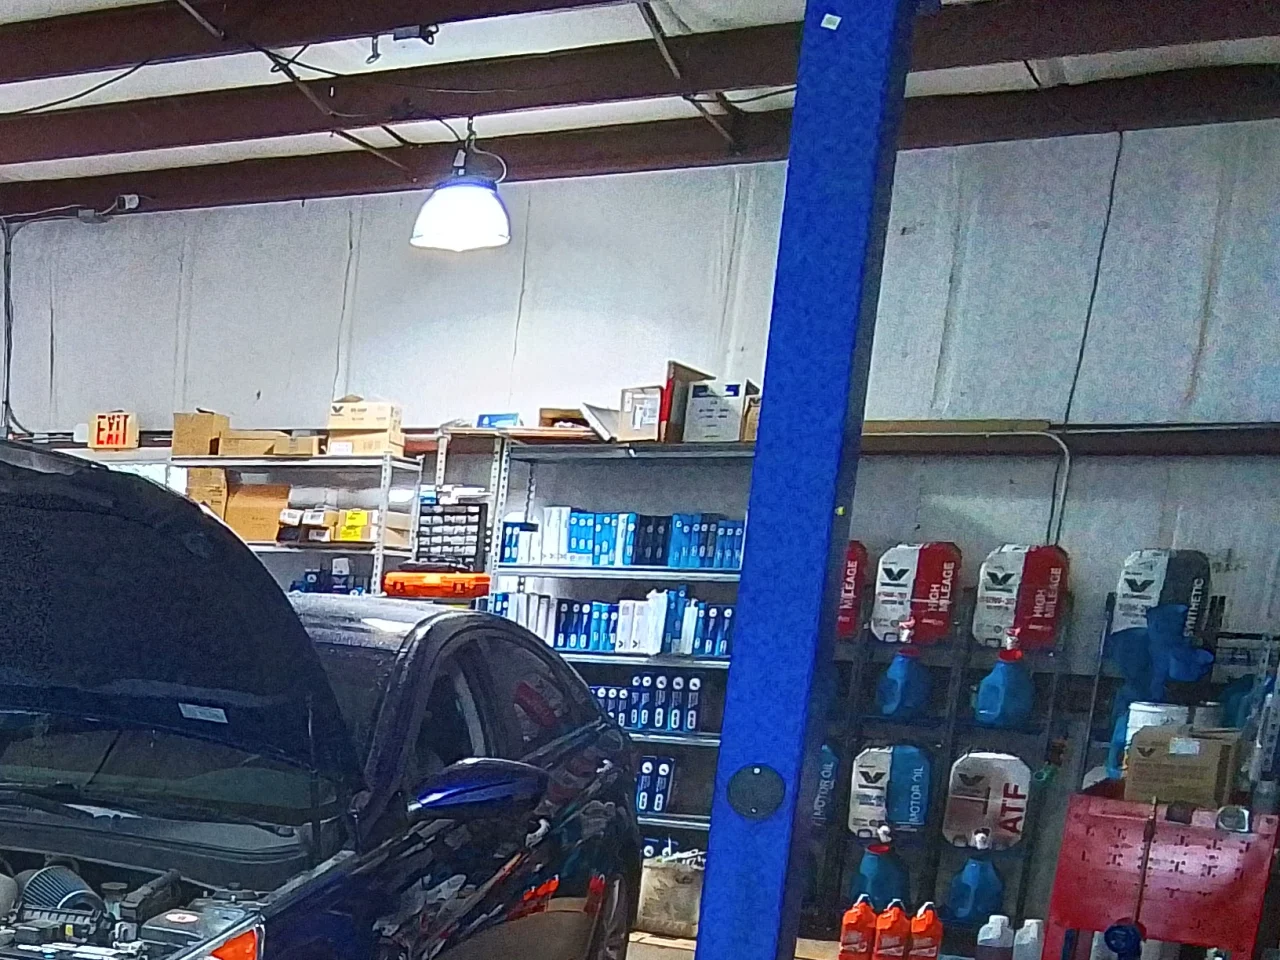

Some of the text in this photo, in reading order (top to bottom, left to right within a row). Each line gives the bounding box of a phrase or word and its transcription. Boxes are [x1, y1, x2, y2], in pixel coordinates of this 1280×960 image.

[97, 414, 129, 445] EXIT
[928, 584, 941, 612] HIGH
[938, 562, 955, 612] MILEAGE
[1033, 589, 1047, 618] HIGH
[1044, 567, 1062, 618] MILEAGE
[909, 766, 924, 823] MOTOR OIL
[999, 783, 1027, 833] ATF
